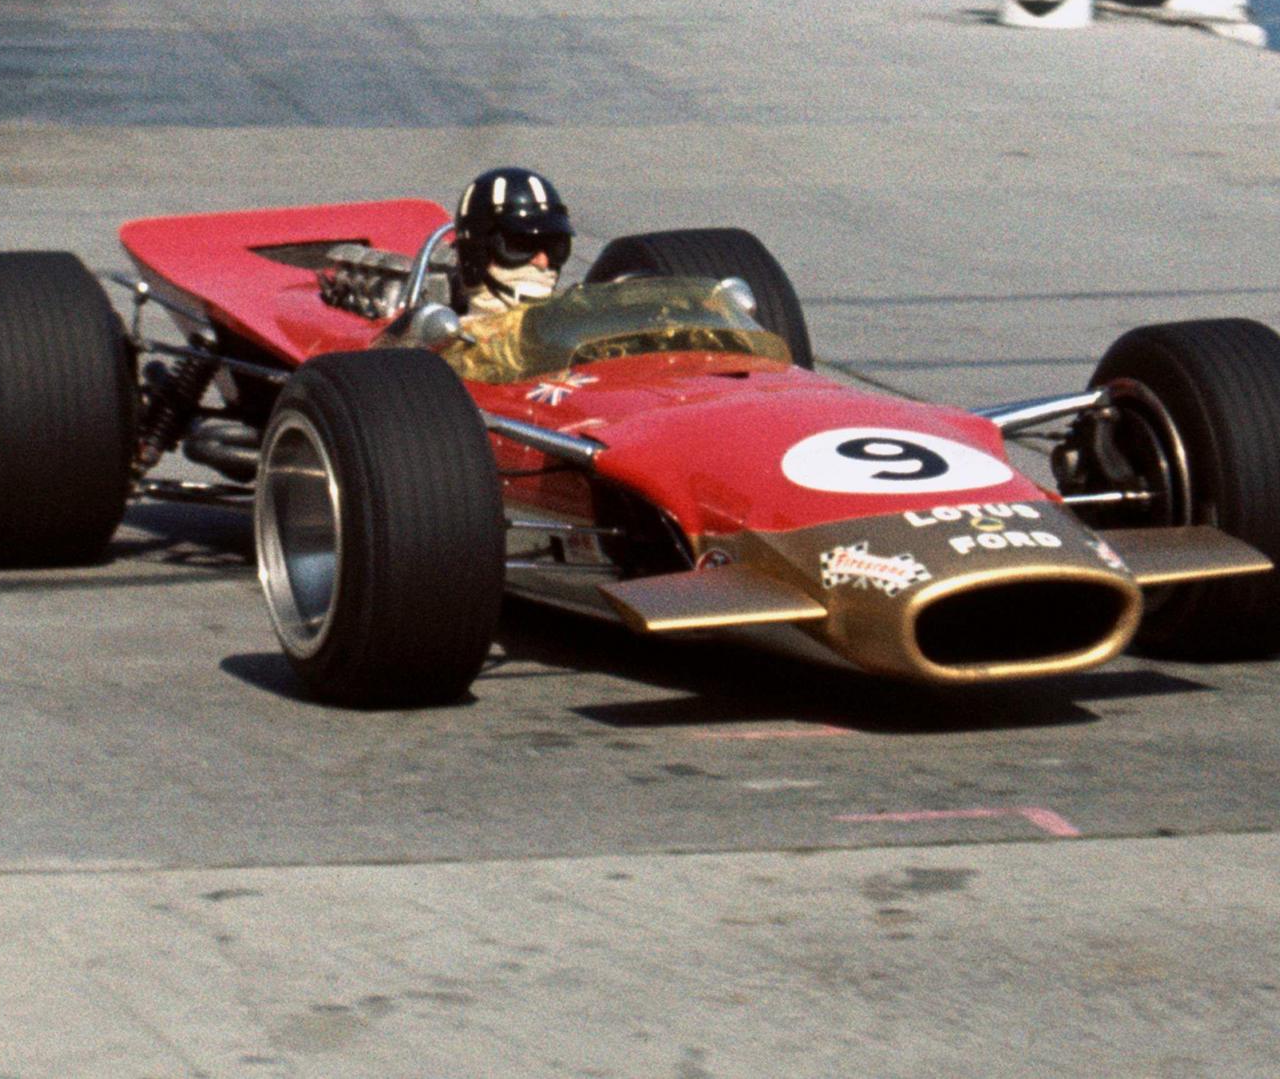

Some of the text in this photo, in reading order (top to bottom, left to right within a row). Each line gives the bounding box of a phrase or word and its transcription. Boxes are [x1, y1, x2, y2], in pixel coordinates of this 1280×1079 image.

[836, 437, 949, 480] 9
[903, 503, 1040, 527] LOTUS
[949, 531, 1062, 555] FORD
